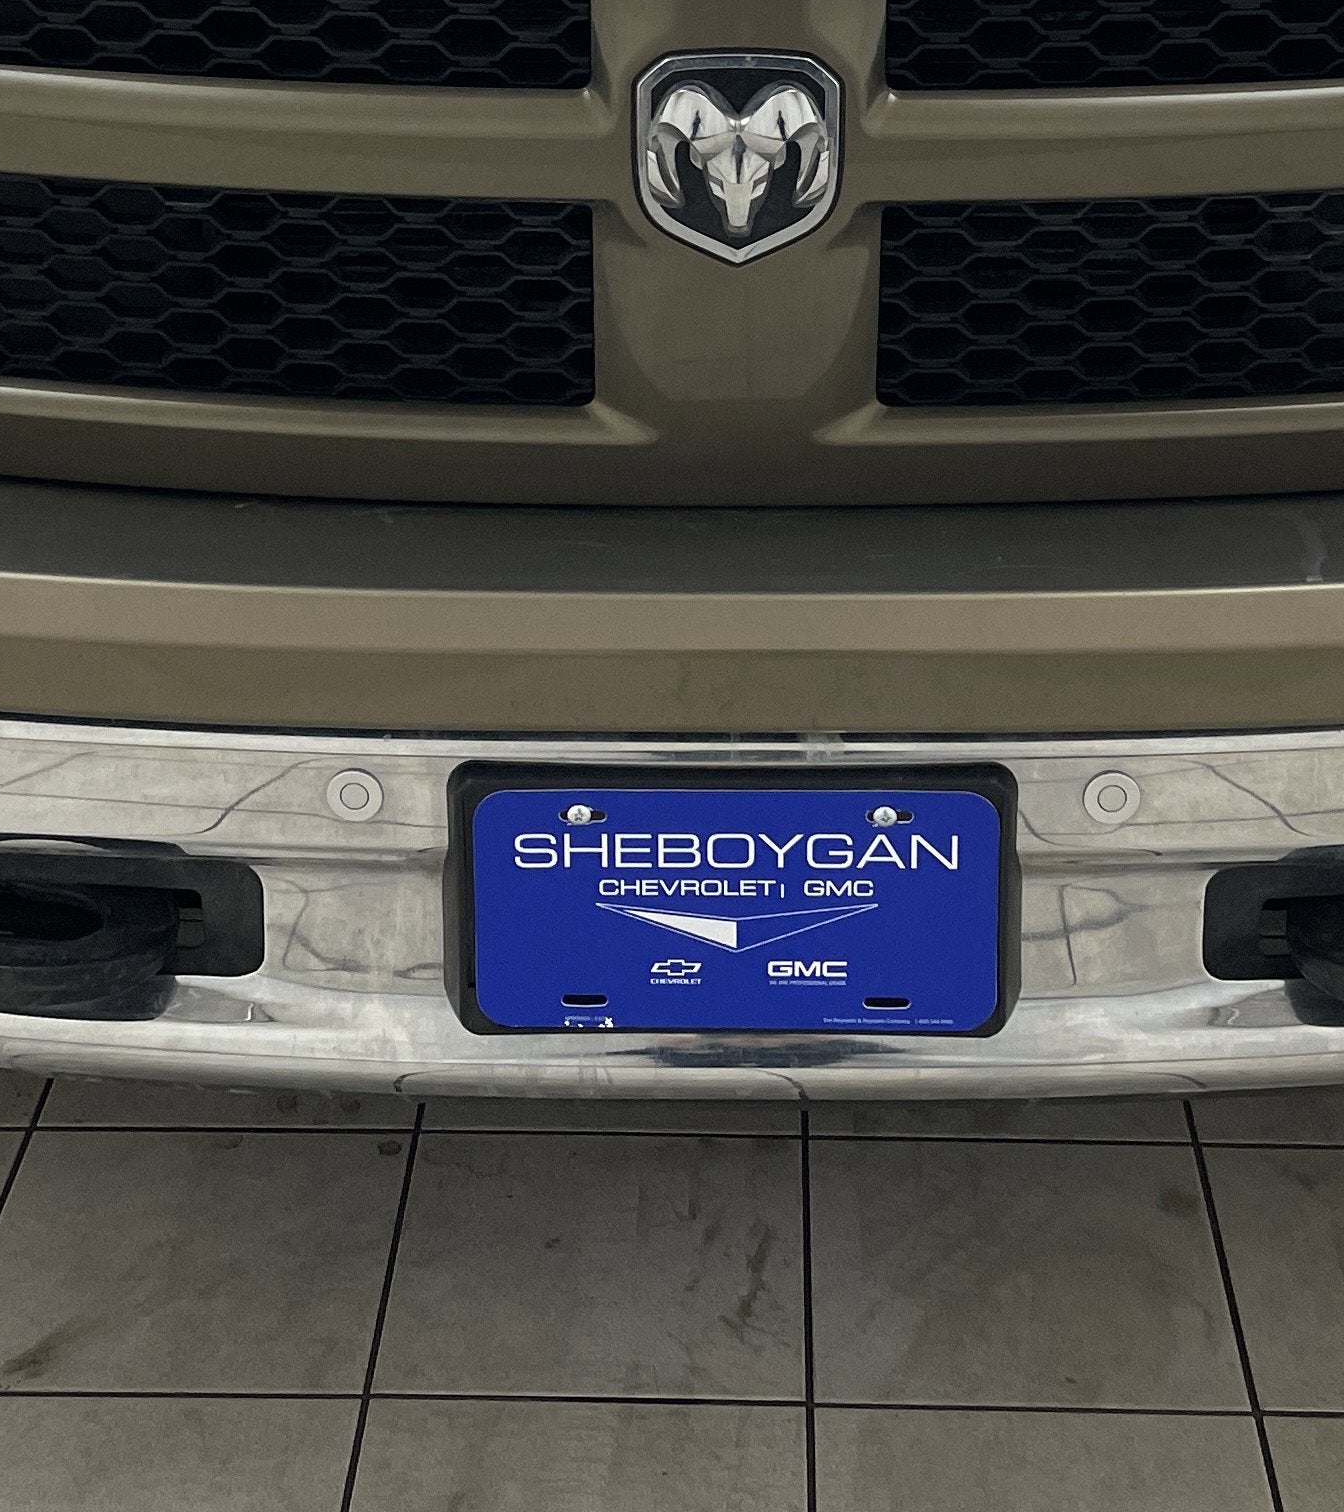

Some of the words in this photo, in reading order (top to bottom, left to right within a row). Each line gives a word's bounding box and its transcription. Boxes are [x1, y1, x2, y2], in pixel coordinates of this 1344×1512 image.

[514, 833, 959, 870] SHEBOYGAN
[598, 879, 777, 897] CHEVROLET
[803, 879, 874, 897] GMC
[767, 960, 848, 978] GMC
